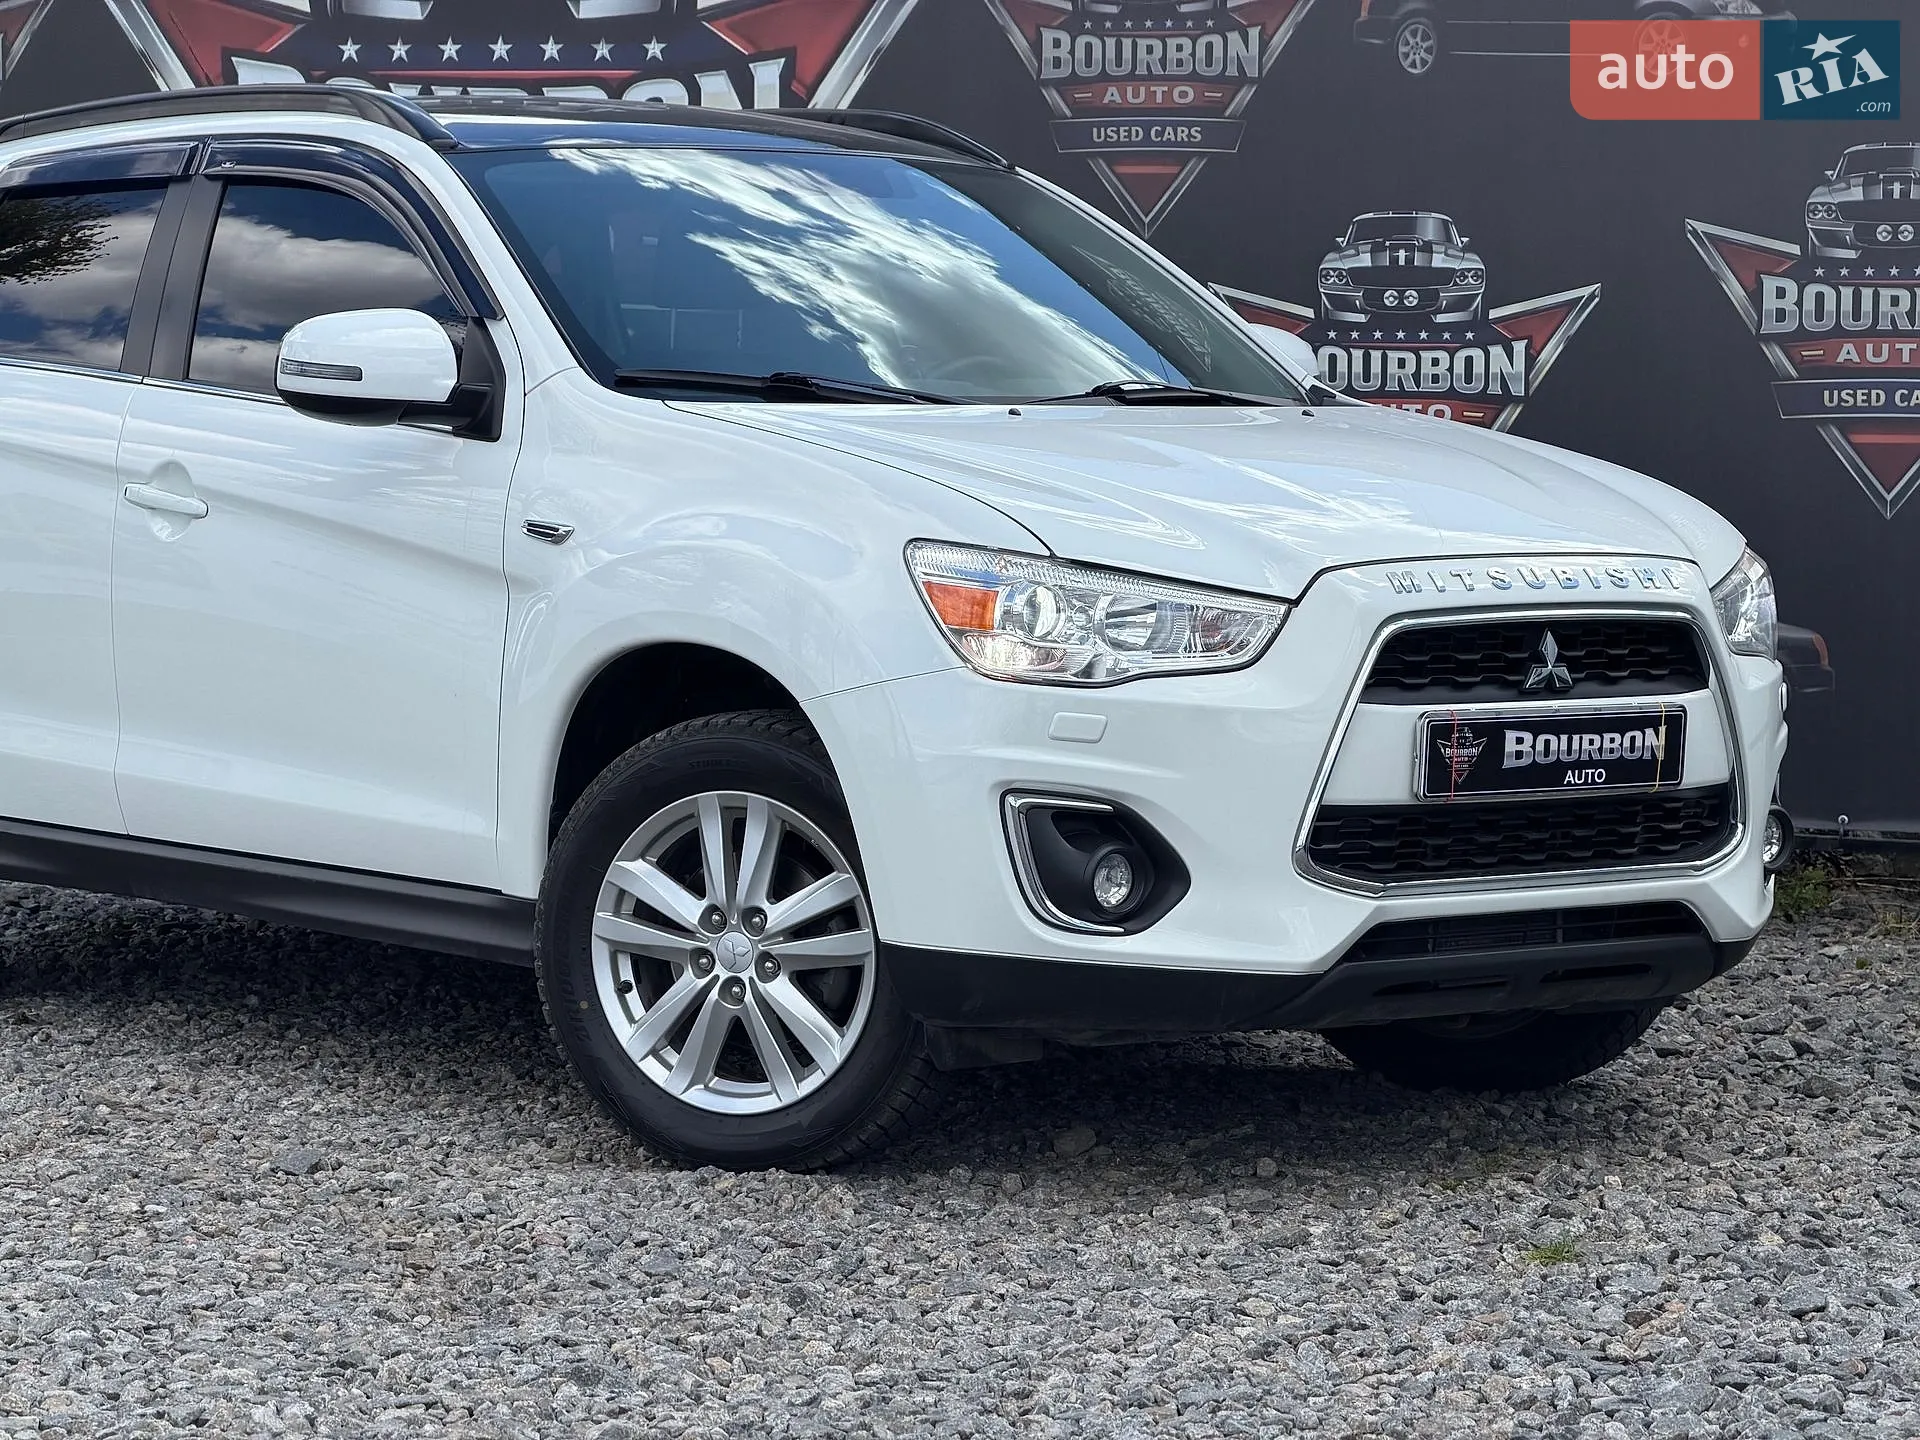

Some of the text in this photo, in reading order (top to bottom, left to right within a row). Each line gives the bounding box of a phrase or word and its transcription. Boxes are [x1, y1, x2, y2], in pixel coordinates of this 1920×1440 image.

[1040, 26, 1262, 79] BOURBON
[1102, 86, 1195, 104] AUTO
[1092, 126, 1202, 142] USED CARS
[1760, 274, 1920, 334] BOUR
[1835, 343, 1918, 363] AUT
[1317, 339, 1529, 396] OURBON
[1823, 389, 1920, 408] USED CA
[1386, 566, 1681, 594] MITSUBISHI
[1502, 725, 1668, 769] BOURBON
[1563, 768, 1606, 785] AUTO
